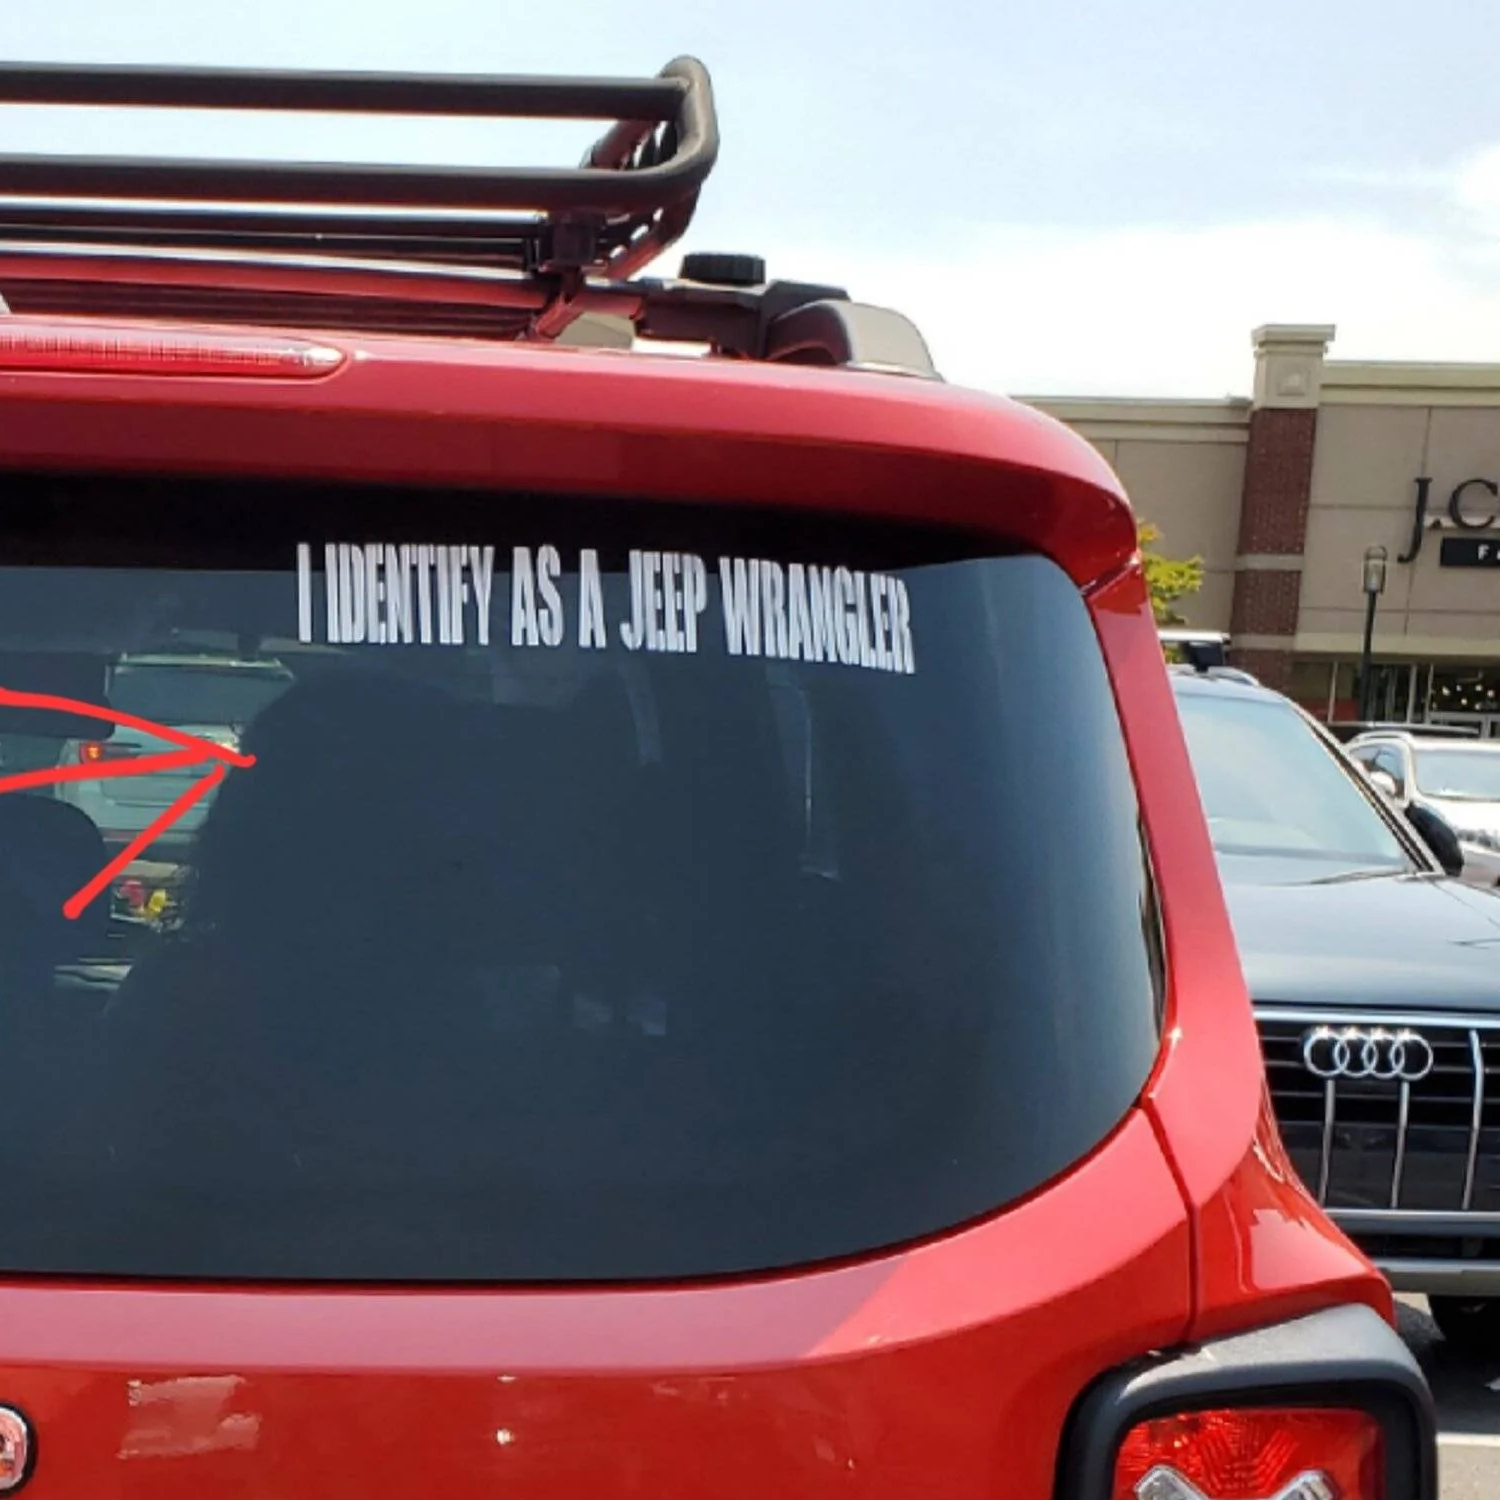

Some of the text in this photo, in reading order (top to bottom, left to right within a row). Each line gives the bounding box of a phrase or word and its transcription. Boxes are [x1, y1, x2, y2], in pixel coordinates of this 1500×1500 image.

[297, 544, 915, 674] I IDENTIFY AS A JEEP WRANGLER
